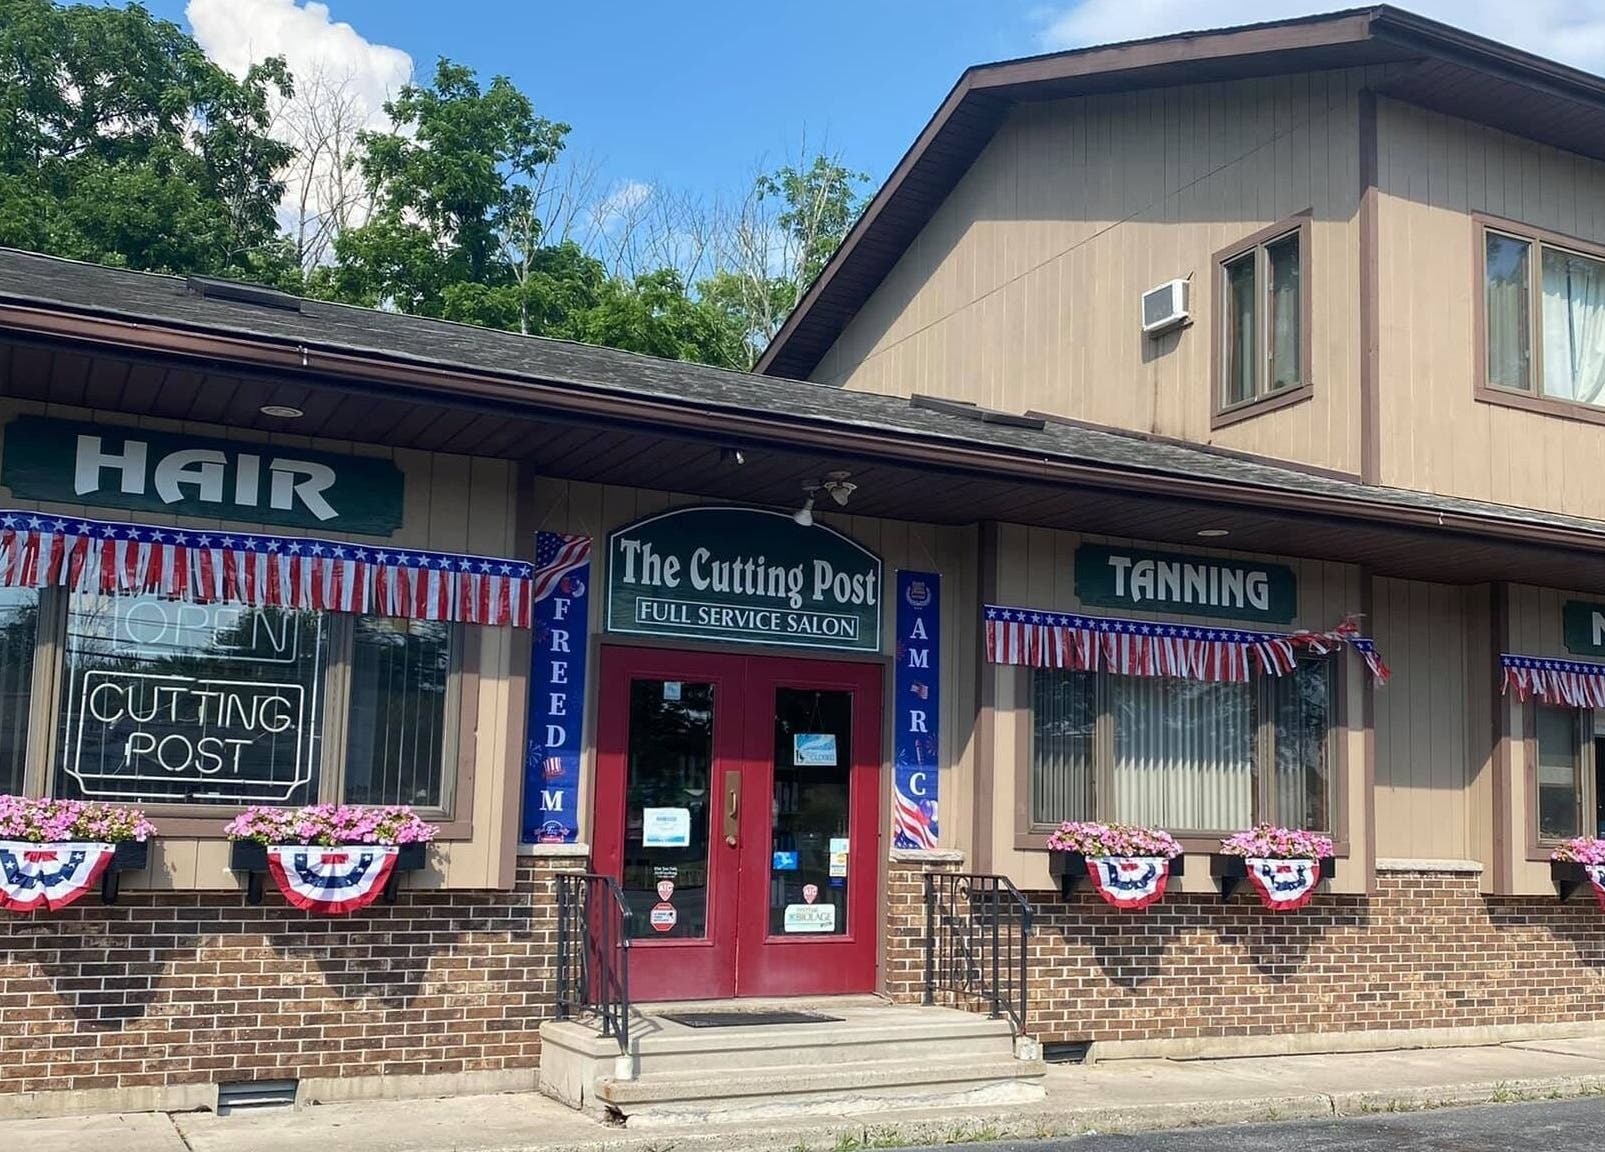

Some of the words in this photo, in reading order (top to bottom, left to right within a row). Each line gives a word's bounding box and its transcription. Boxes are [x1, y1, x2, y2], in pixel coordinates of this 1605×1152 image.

[74, 434, 339, 521] HAIR
[620, 538, 681, 588] The
[690, 547, 804, 609] Cutting
[813, 559, 877, 606] Post
[1108, 555, 1269, 611] TANNING
[125, 601, 290, 652] OPEN
[641, 601, 691, 623] FULL
[698, 607, 781, 631] SERVICE
[787, 615, 856, 637] SALON
[90, 683, 292, 733] CUTTING
[125, 732, 254, 774] POST
